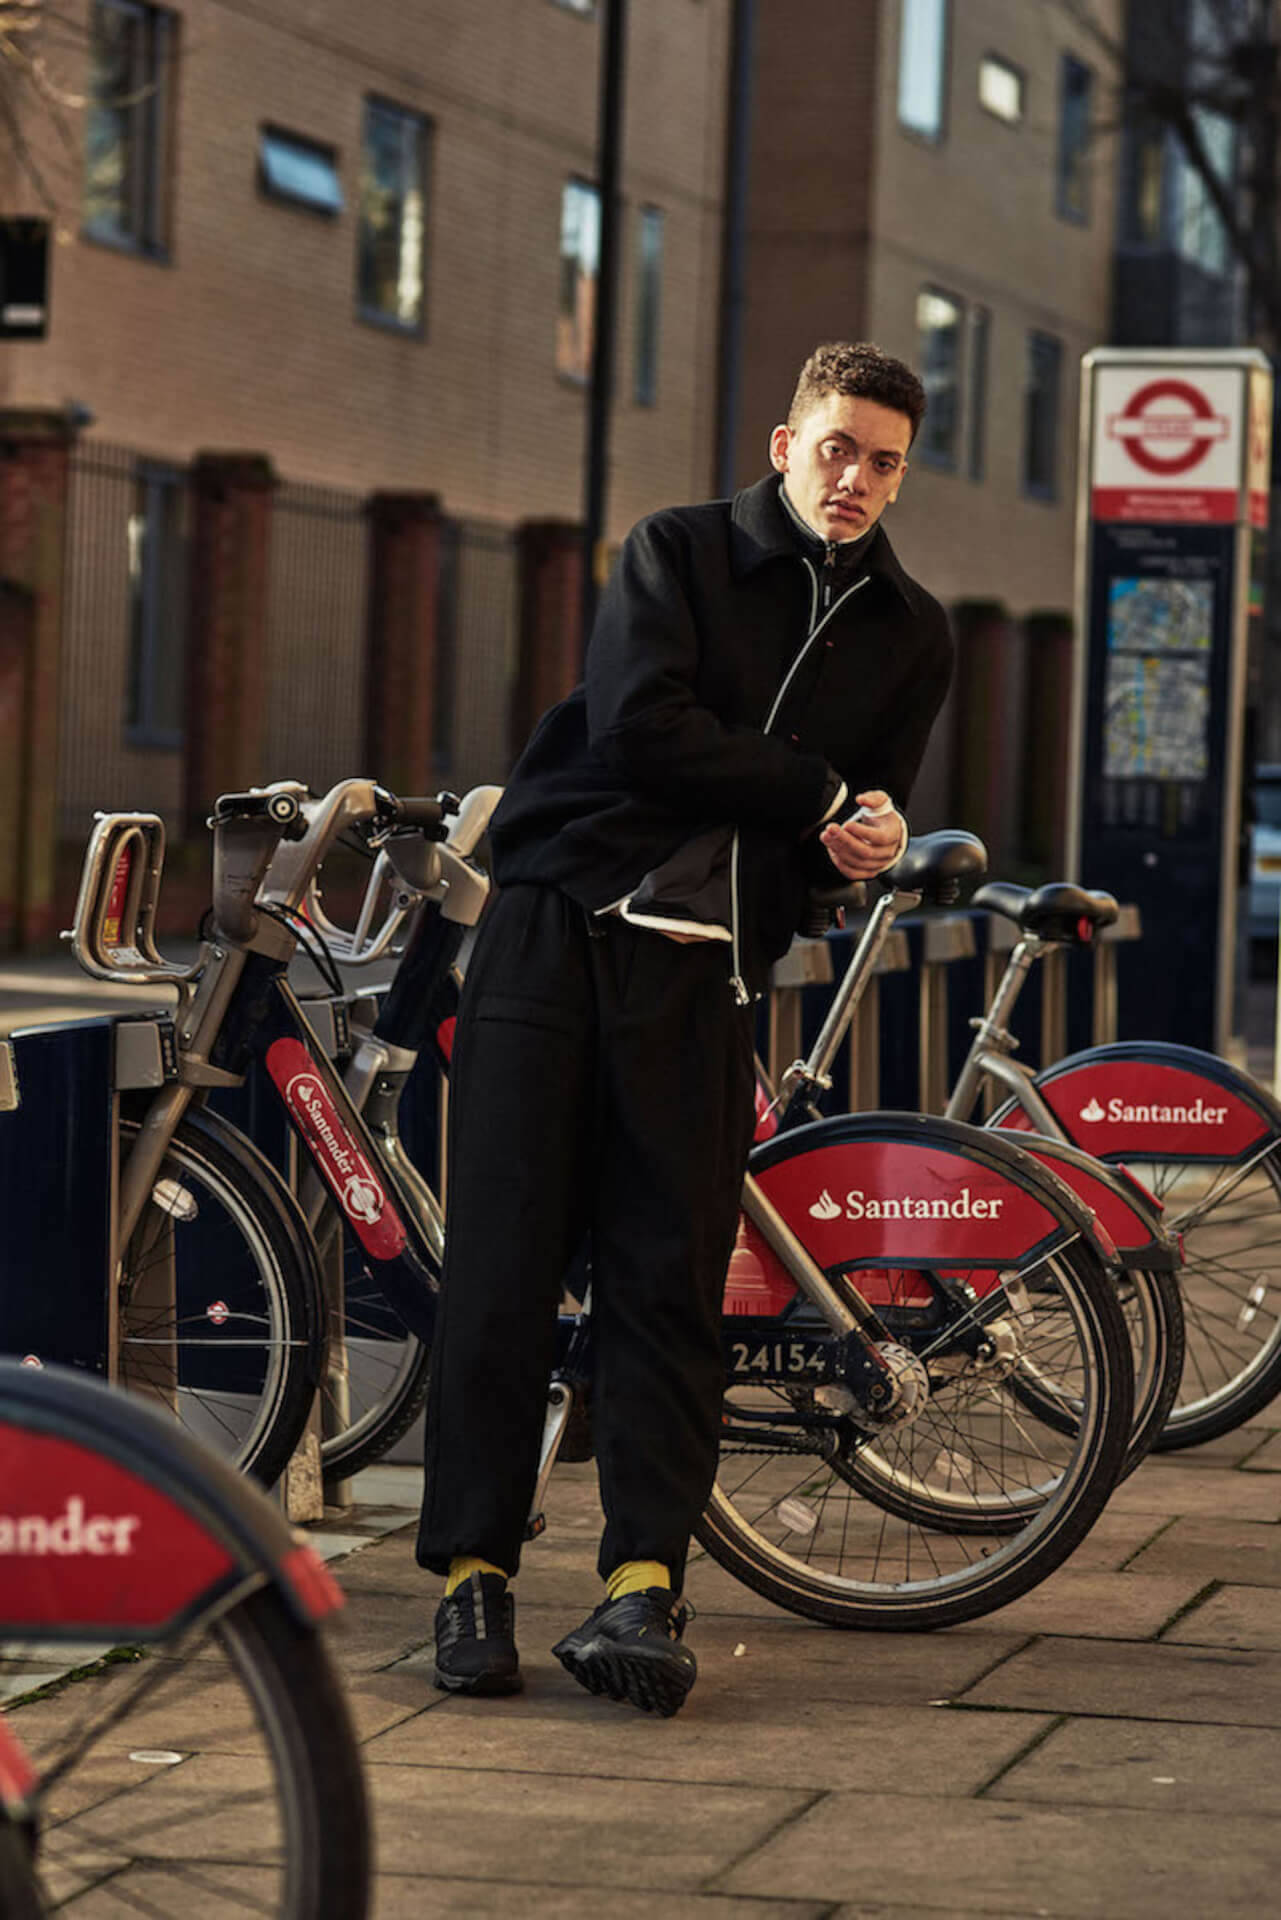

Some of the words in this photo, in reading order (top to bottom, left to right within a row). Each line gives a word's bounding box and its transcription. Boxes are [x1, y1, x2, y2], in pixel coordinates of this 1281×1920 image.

[1107, 1098, 1228, 1124] Santander
[305, 1099, 354, 1174] Santander
[845, 1188, 1003, 1220] Santander
[732, 1343, 826, 1372] 24154
